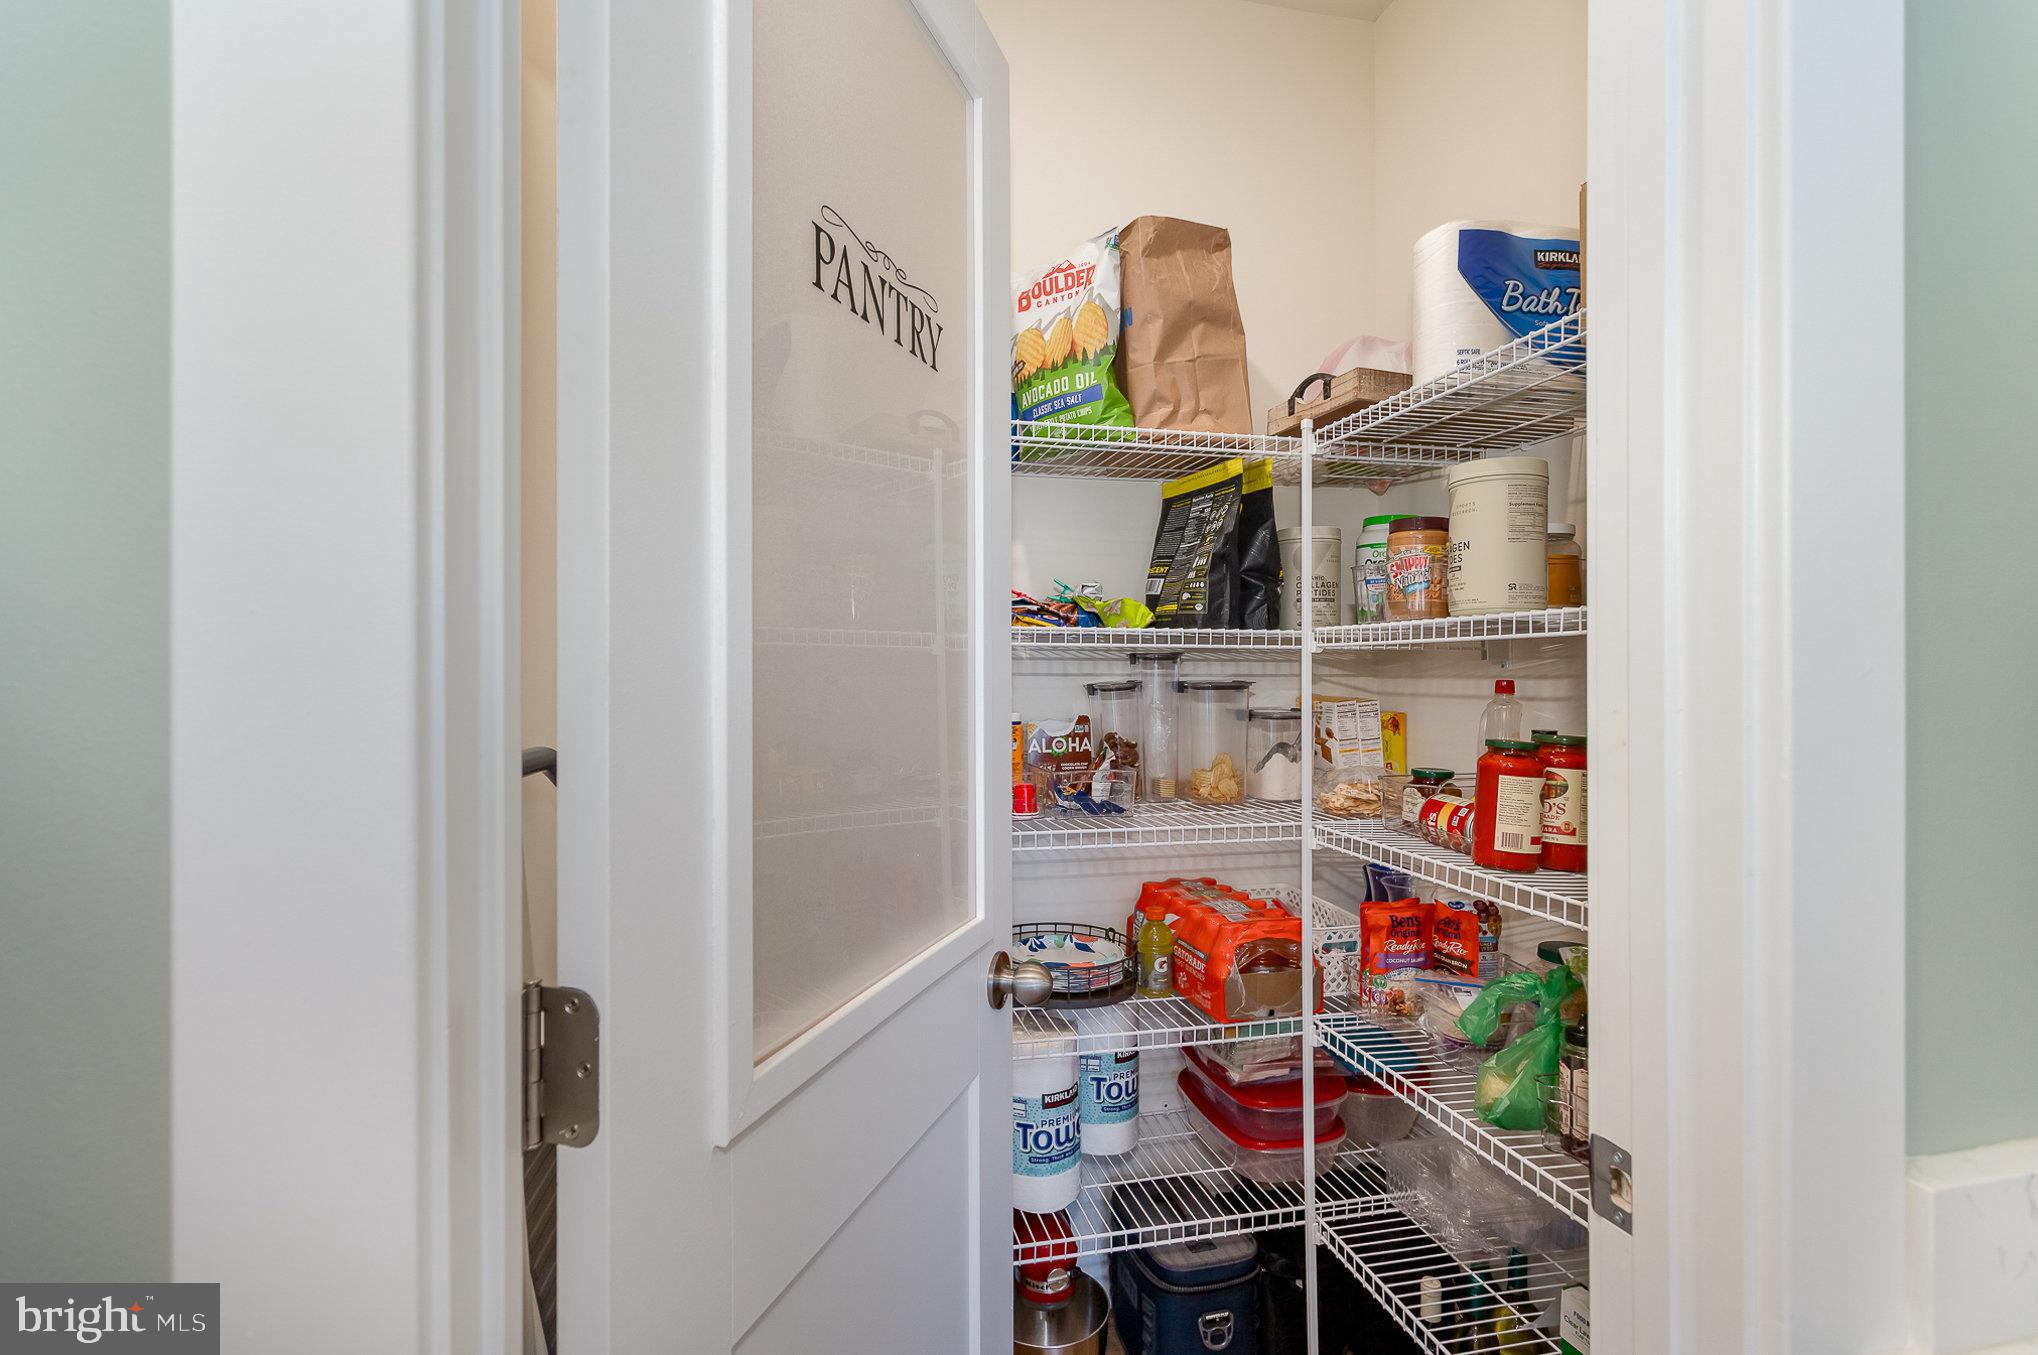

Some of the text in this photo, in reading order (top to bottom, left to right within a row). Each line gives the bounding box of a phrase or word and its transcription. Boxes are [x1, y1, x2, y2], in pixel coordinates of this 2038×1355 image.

[1537, 251, 1580, 263] KIRKLA
[811, 220, 943, 372] PANTRY
[1018, 264, 1096, 313] BOULDER
[1036, 290, 1080, 308] CANYON
[1501, 280, 1566, 314] Bath
[1022, 371, 1097, 409] AVOCADO OIL
[1032, 394, 1082, 418] CLASSIC SEA SALT
[1028, 737, 1092, 753] ALOHA
[1389, 914, 1421, 929] Ben's
[1173, 946, 1206, 973] GATORADE
[1384, 940, 1413, 955] Ready
